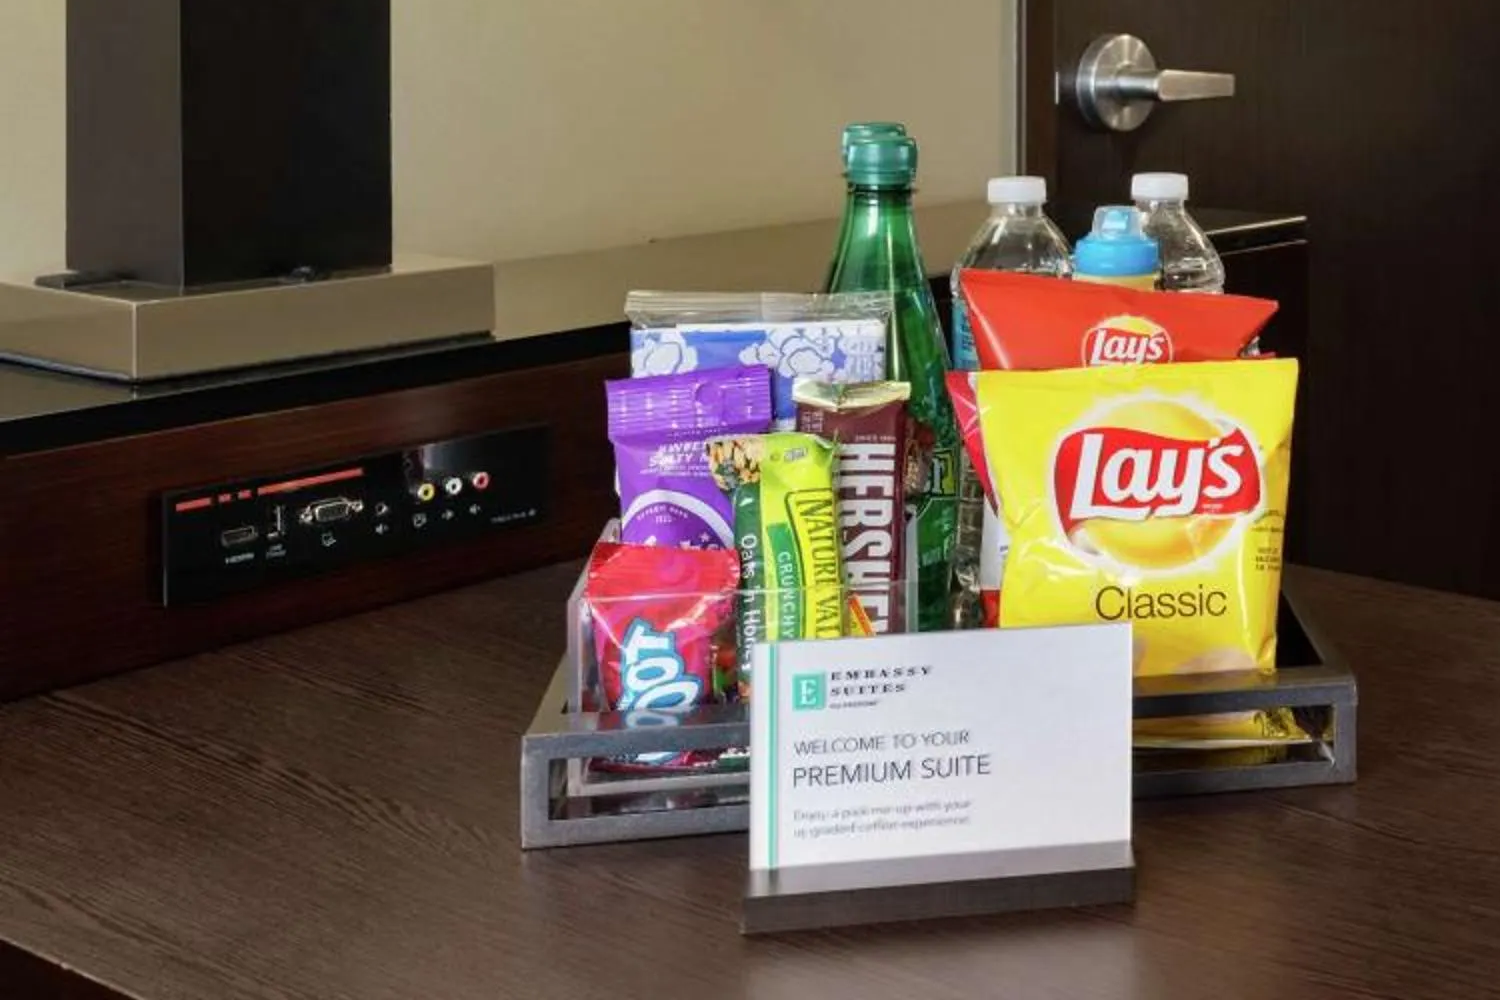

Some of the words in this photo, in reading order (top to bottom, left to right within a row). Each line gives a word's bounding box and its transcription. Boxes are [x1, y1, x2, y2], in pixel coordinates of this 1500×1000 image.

[1070, 432, 1246, 521] Lay's
[741, 533, 757, 579] Oats
[795, 498, 839, 586] NATURE
[777, 551, 797, 640] CRUNCHY
[815, 594, 840, 637] VAL
[1095, 584, 1227, 621] Classic
[831, 665, 932, 681] EMBASSY
[831, 683, 906, 696] SUITES
[793, 735, 885, 755] WELCOME
[893, 733, 917, 749] TO
[920, 729, 970, 747] YOUR
[793, 759, 912, 788] PREMIUM
[921, 753, 991, 779] SUITE
